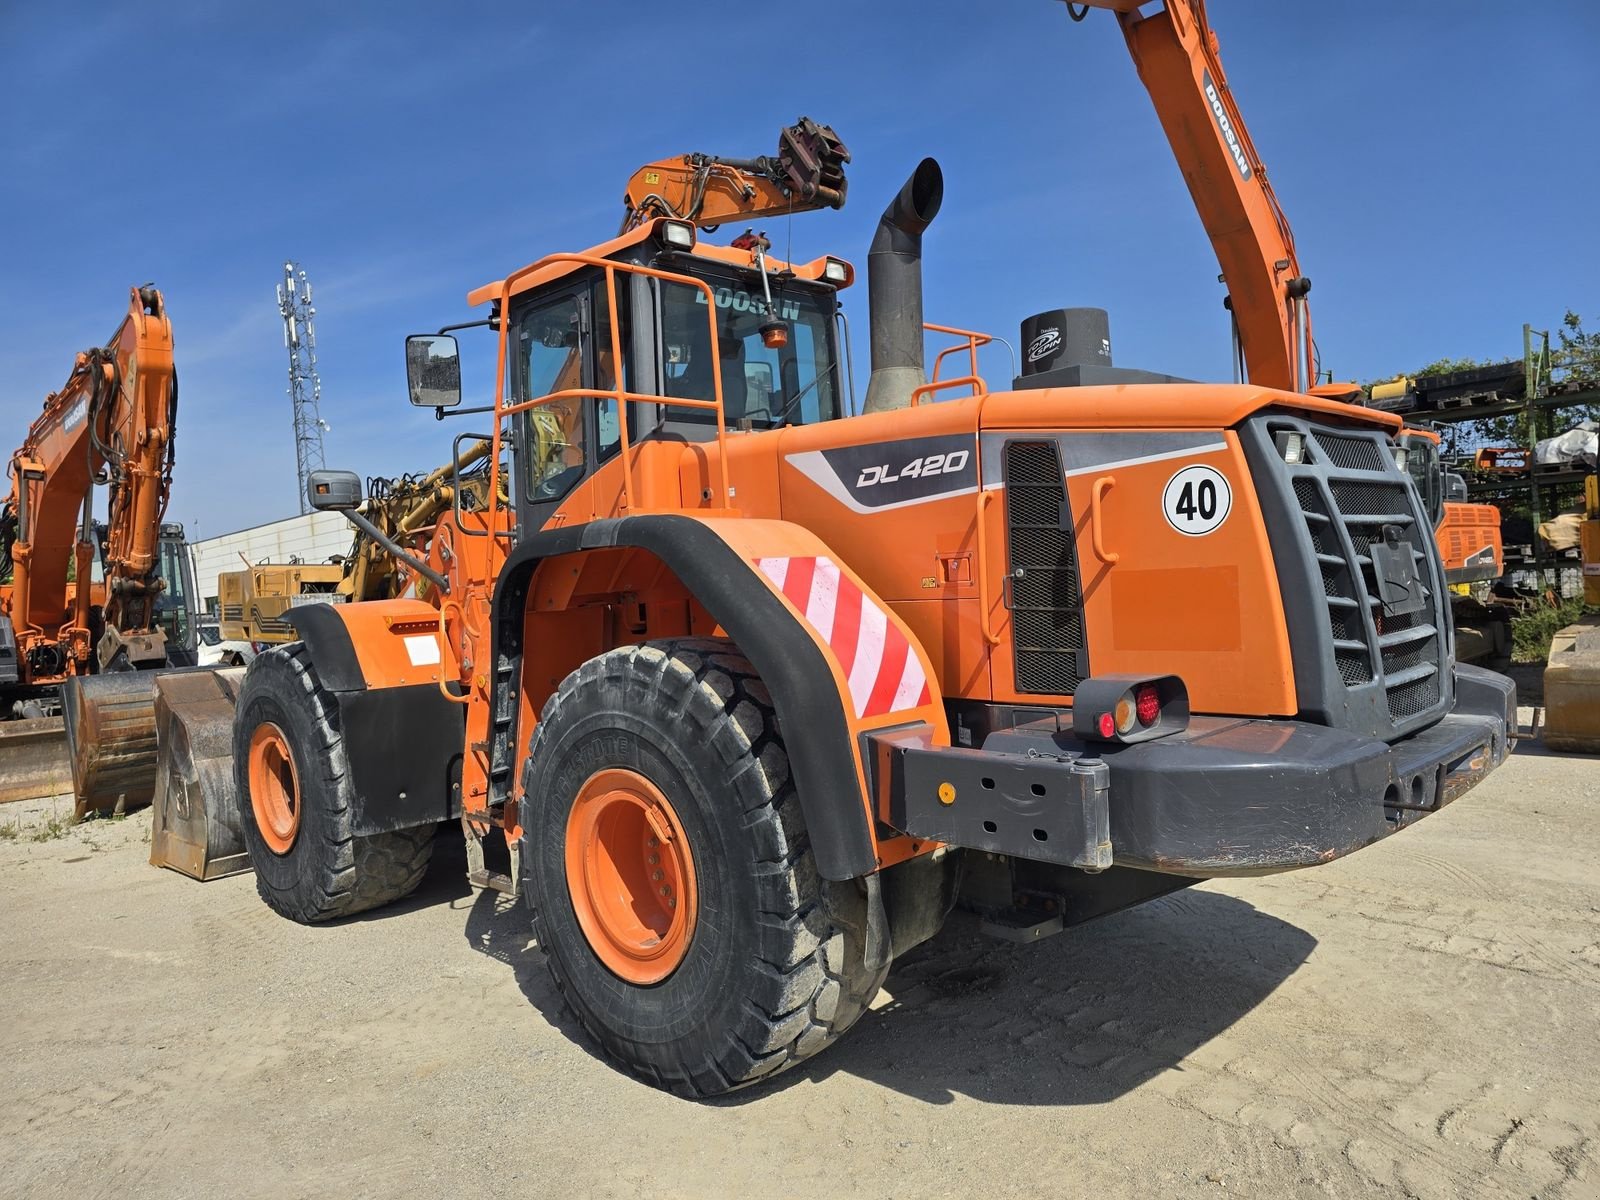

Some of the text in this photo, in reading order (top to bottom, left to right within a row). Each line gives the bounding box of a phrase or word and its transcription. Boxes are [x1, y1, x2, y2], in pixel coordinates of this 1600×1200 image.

[1206, 84, 1248, 174] DOOSAN
[696, 287, 800, 320] DOOSN
[1028, 338, 1047, 354] TOP
[1038, 337, 1062, 354] SPIN
[856, 450, 969, 488] DL420
[1176, 479, 1217, 520] 40
